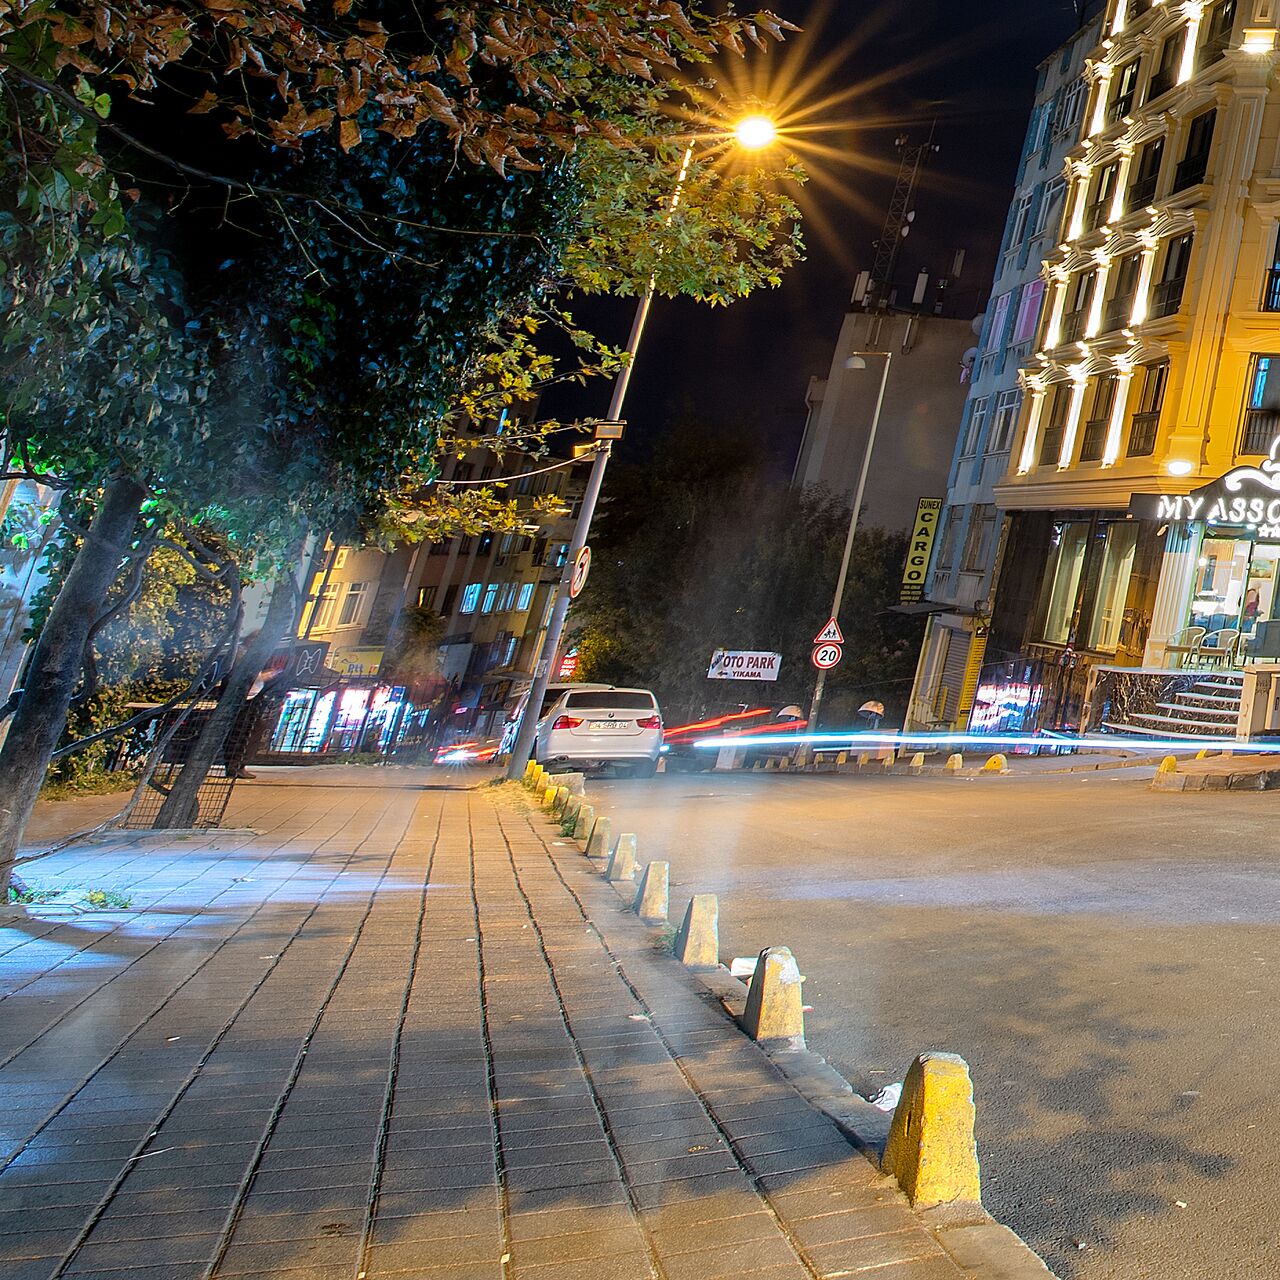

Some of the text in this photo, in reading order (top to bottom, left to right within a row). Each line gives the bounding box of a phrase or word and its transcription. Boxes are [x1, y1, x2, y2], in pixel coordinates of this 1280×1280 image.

[920, 500, 940, 510] SUNEX
[907, 512, 934, 581] CARGO
[723, 655, 744, 668] OTO
[746, 656, 776, 669] PARK
[819, 650, 836, 662] 20
[732, 670, 762, 678] YIKAMA
